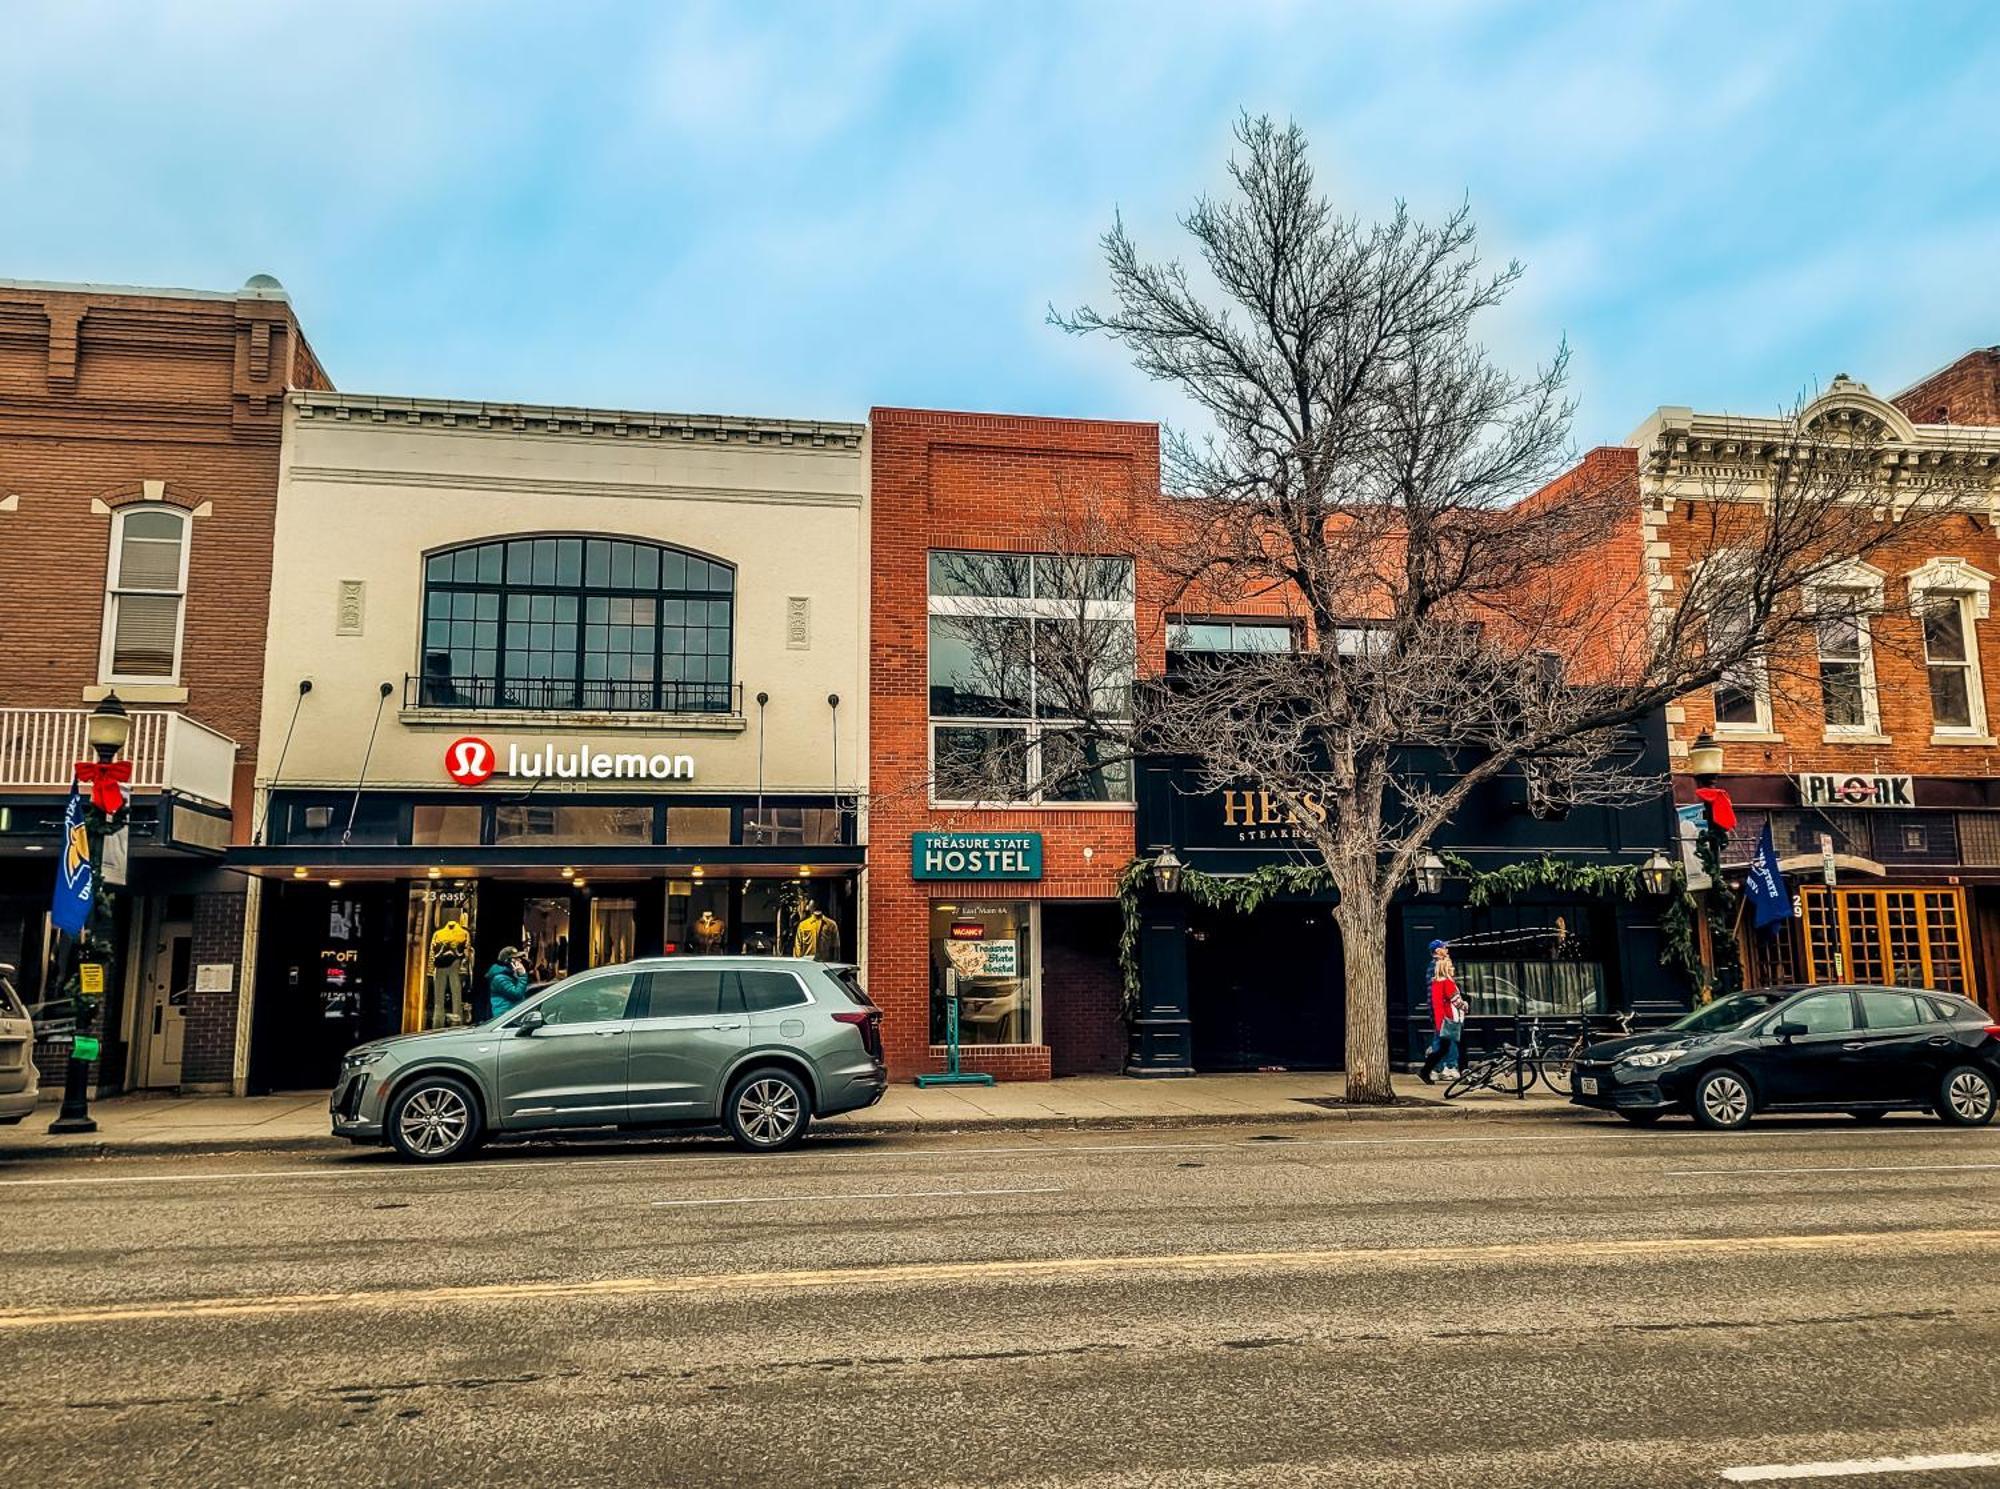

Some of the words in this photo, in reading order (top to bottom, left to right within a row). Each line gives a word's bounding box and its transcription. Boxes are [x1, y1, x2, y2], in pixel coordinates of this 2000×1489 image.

[509, 743, 695, 778] lululemon
[926, 838, 990, 849] TREASURE
[994, 839, 1030, 849] STATE
[926, 851, 1030, 872] HOSTEL
